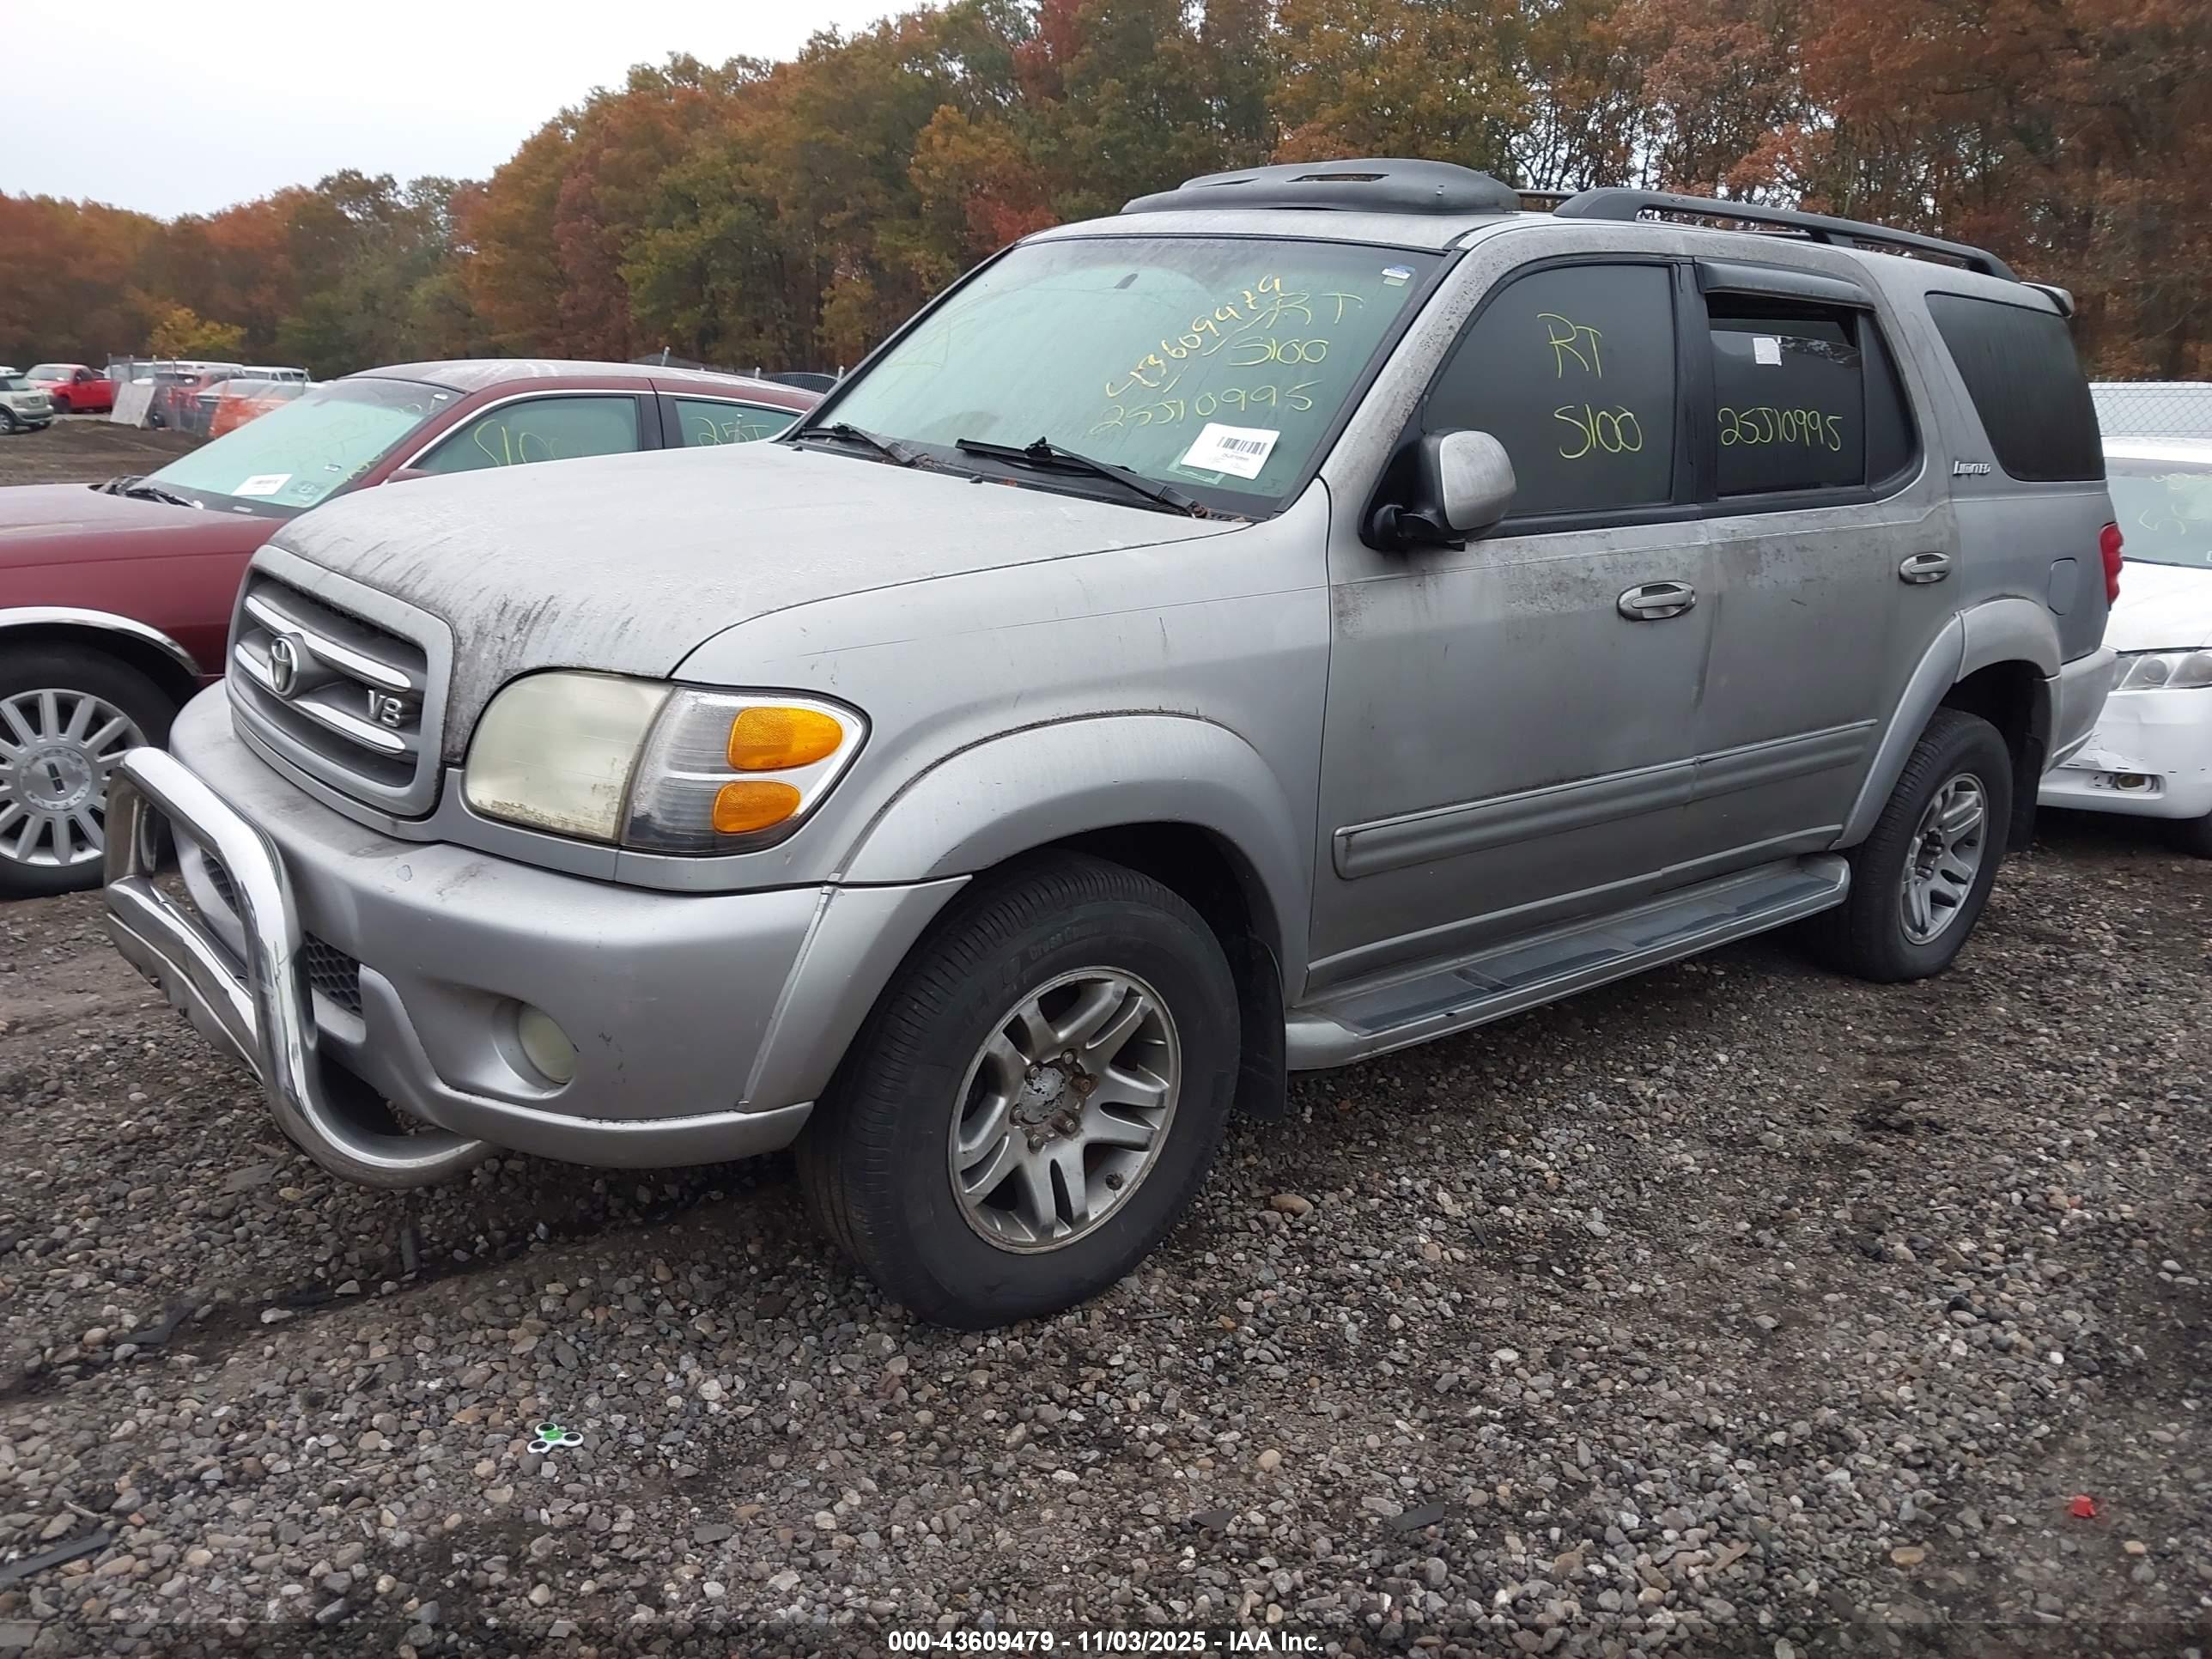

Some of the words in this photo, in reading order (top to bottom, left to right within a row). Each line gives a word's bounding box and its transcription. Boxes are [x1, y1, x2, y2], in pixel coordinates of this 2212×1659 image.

[1536, 313, 1603, 379] RT
[1717, 406, 1844, 452] 25J10995
[366, 688, 404, 728] V8
